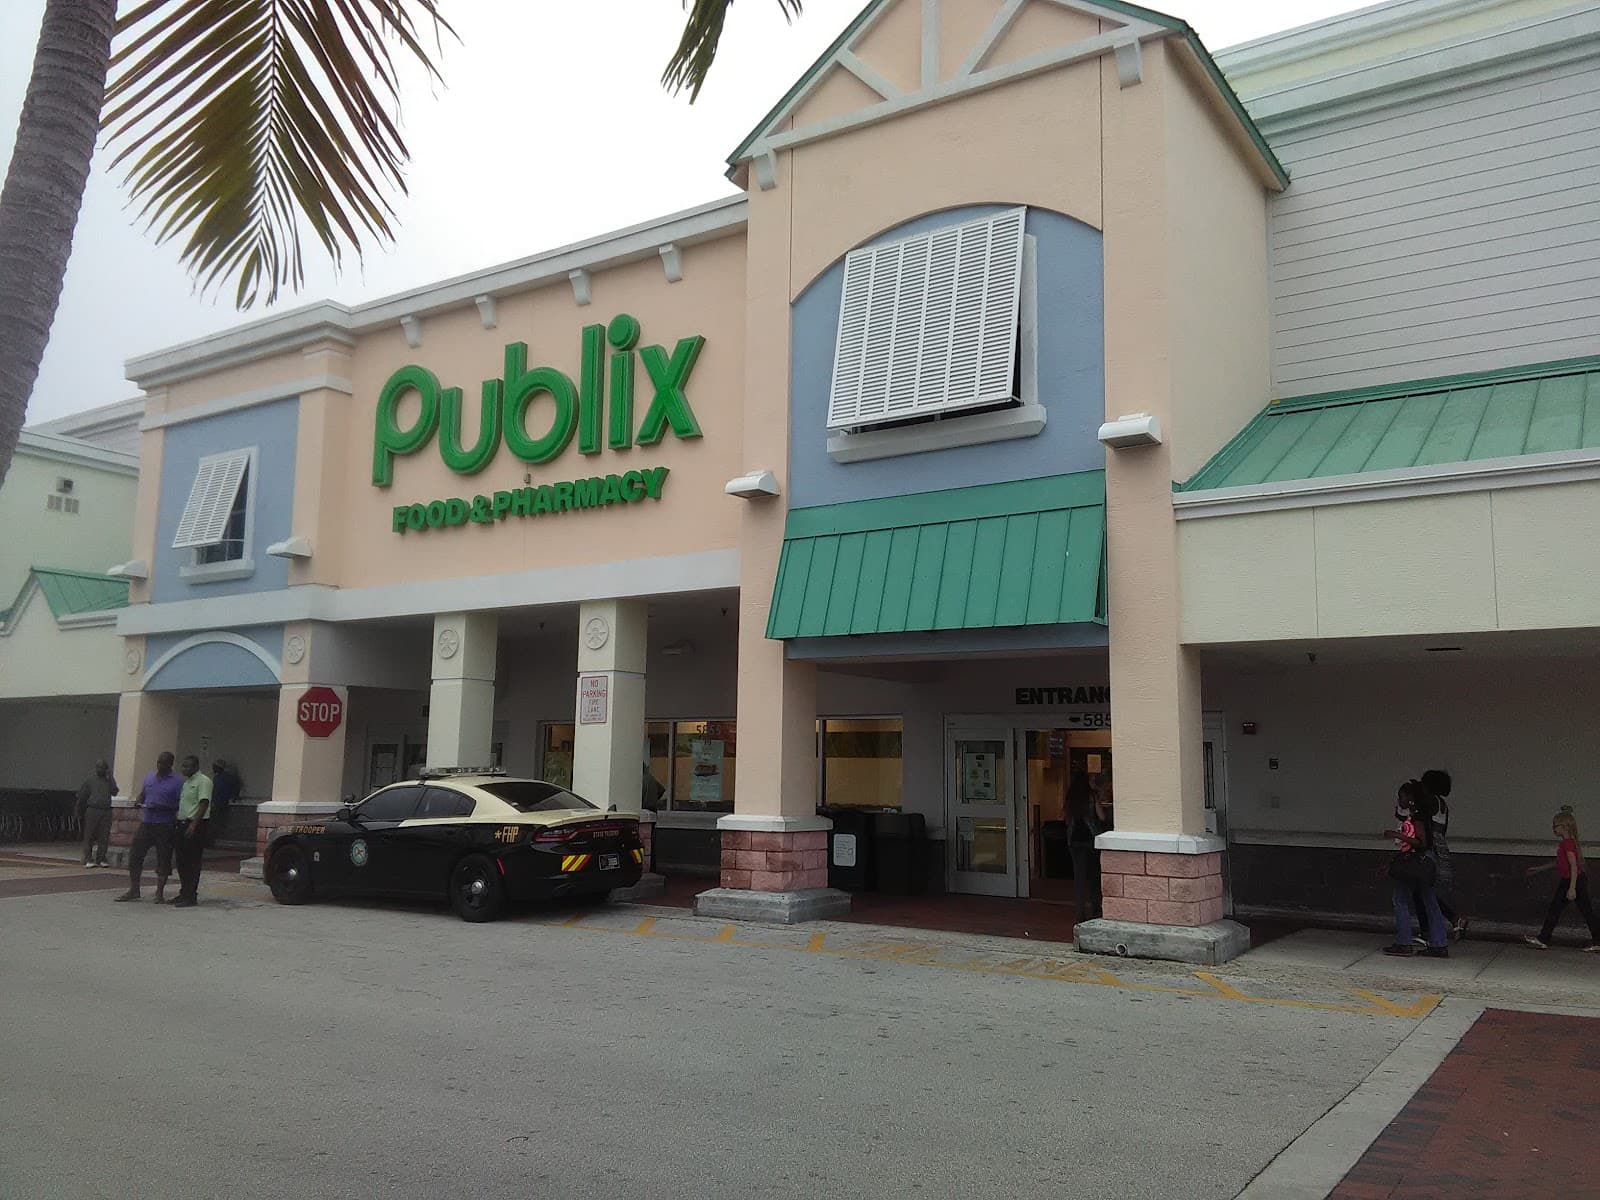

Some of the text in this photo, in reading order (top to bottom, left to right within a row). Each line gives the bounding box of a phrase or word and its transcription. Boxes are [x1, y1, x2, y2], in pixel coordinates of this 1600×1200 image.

[392, 497, 470, 534] FOOD
[492, 466, 671, 521] PHARMACY
[590, 679, 599, 688] NO
[583, 690, 606, 698] PARKING
[300, 702, 340, 722] STOP
[502, 826, 519, 843] FHP
